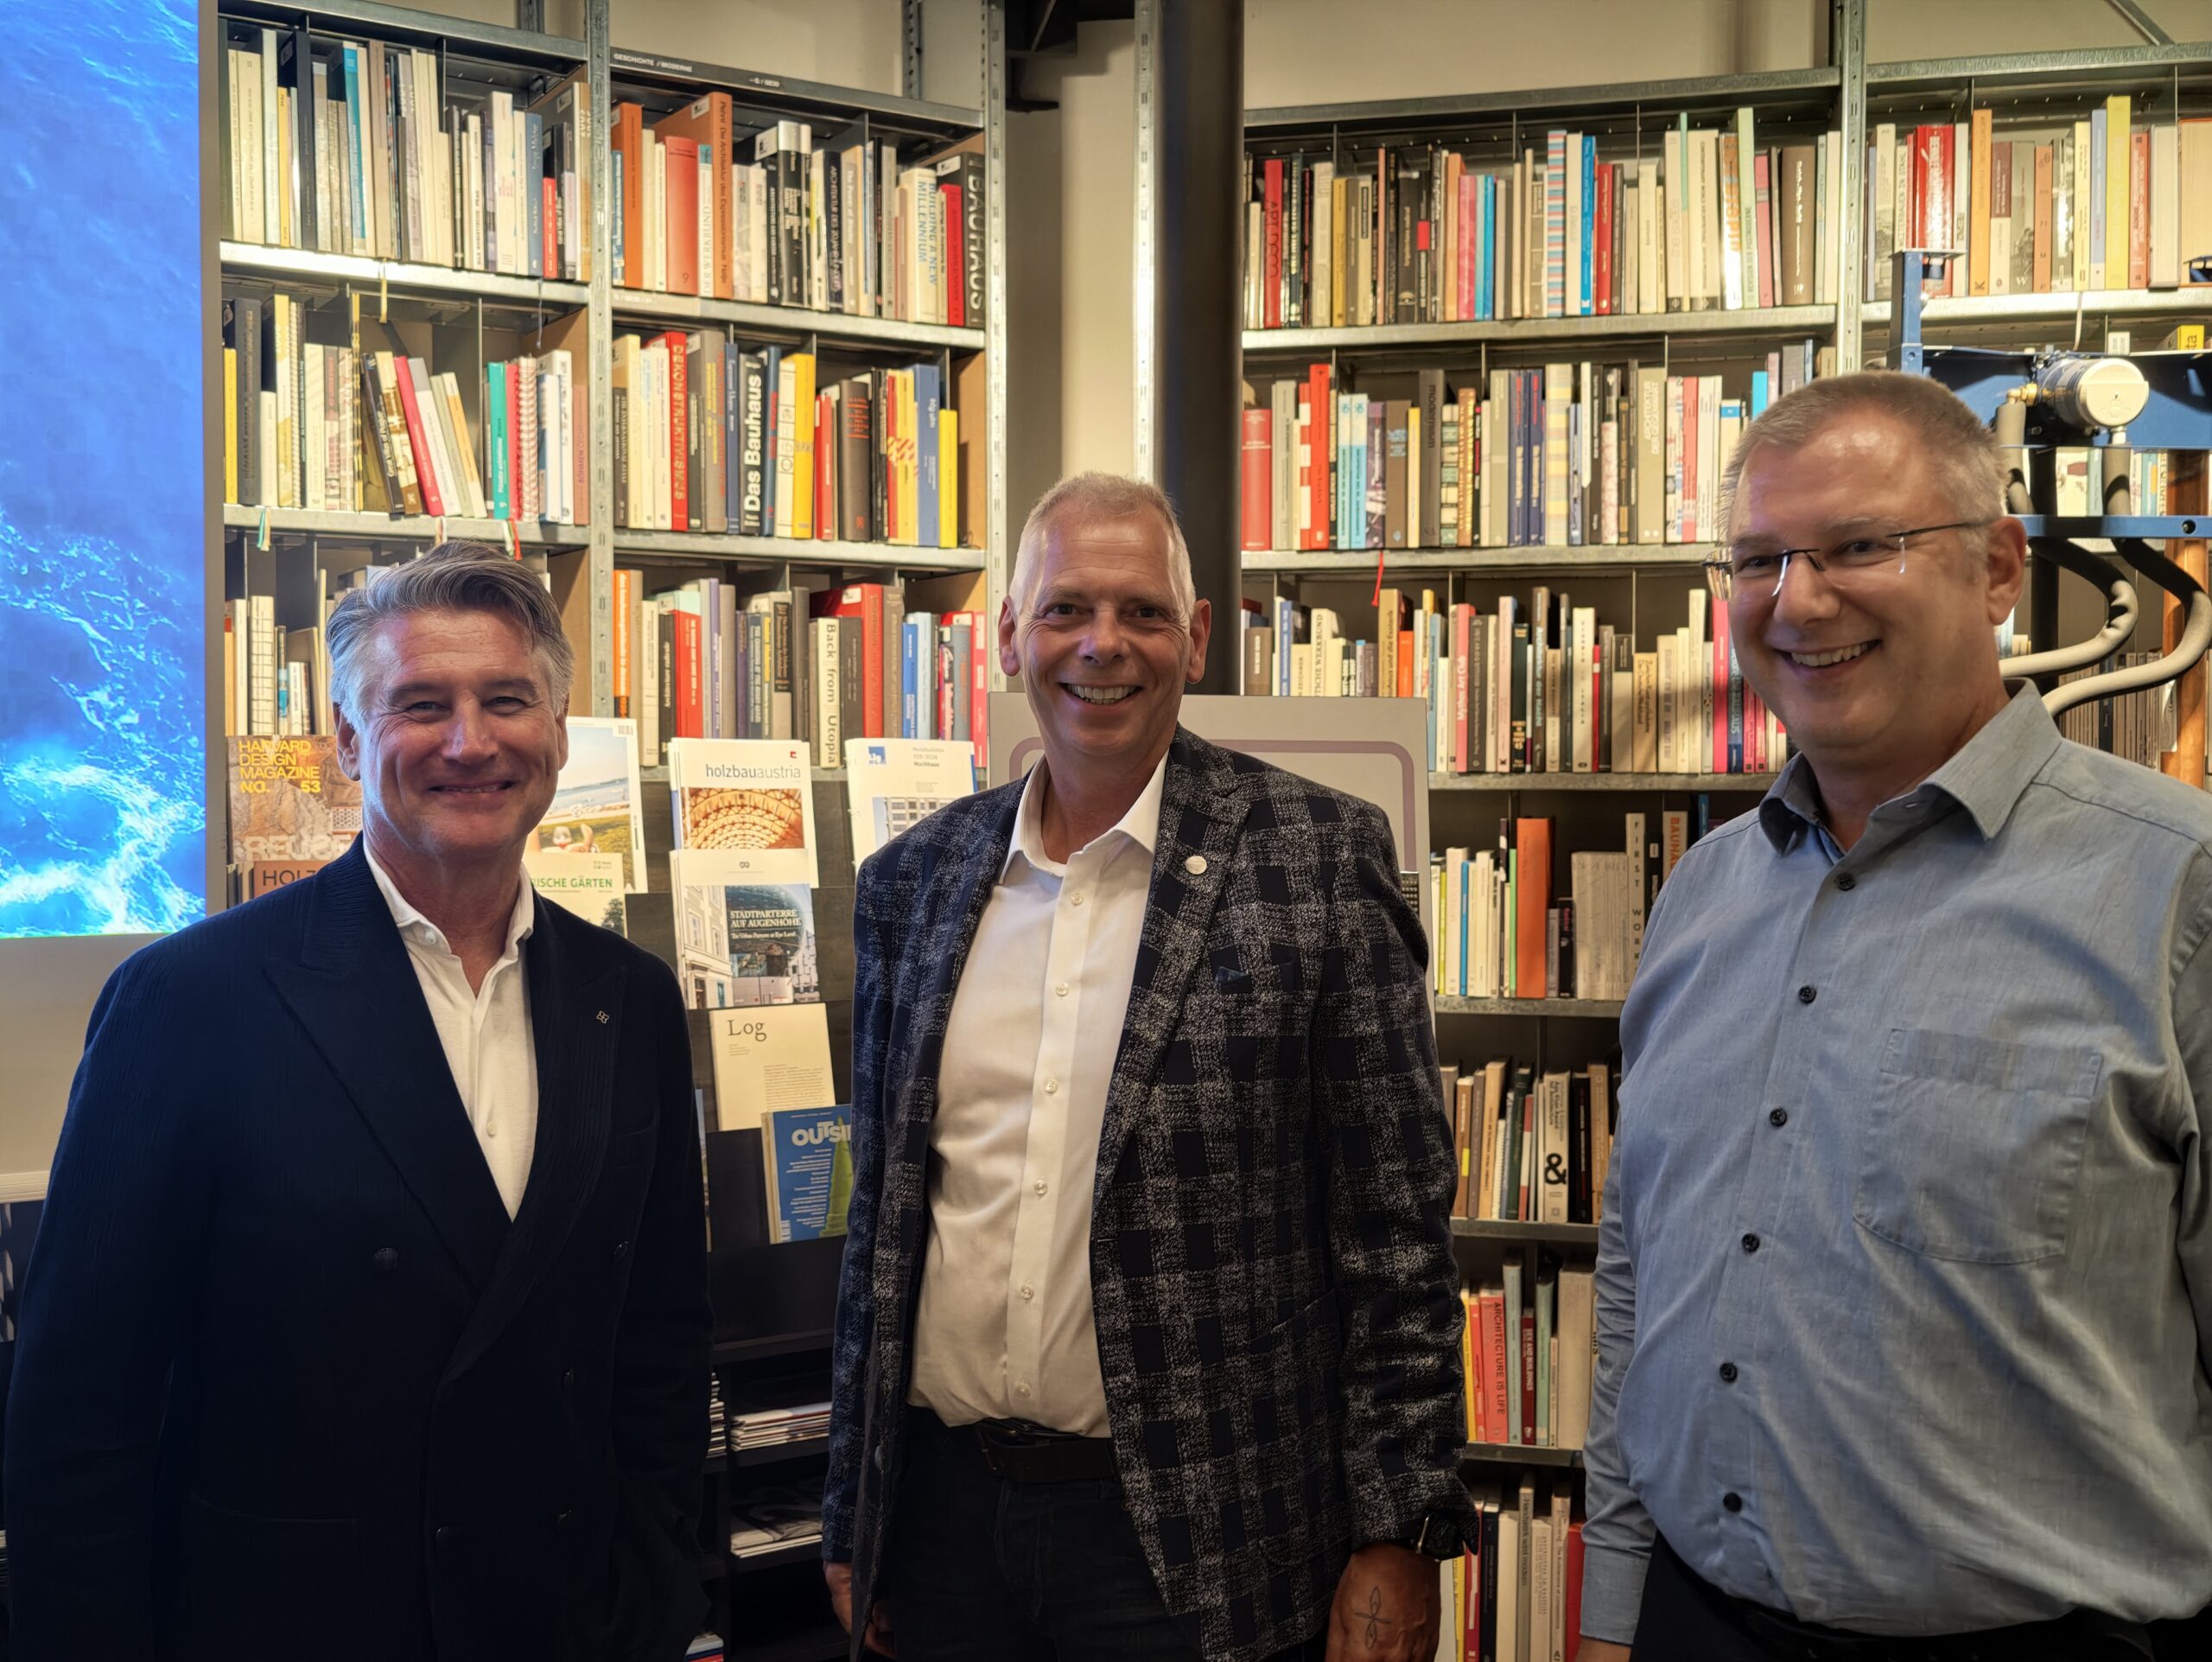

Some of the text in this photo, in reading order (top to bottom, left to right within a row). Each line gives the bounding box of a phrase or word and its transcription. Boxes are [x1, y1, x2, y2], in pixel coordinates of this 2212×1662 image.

[613, 53, 693, 73] GESCHICHTE MODERNE
[719, 141, 728, 181] Architektur
[918, 181, 927, 262] MILLENNIUM
[1265, 201, 1279, 228] ART
[702, 206, 712, 294] DER WERKBUND
[967, 175, 985, 310] BAUHAUS
[672, 344, 685, 500] DEKONSTRUKTIVISMUS
[1427, 385, 1437, 449] modernism
[1643, 381, 1652, 440] ARCHITEKTUR
[744, 374, 761, 512] Das Bauhaus
[1314, 614, 1324, 695] TSCHE WERKBUND
[825, 623, 837, 764] Back from Utopia
[1457, 690, 1466, 720] Mythos
[238, 740, 311, 753] HARVARD
[239, 753, 297, 767] DESIGN
[239, 766, 321, 780] MAGAZINE
[239, 780, 321, 793] NO. 53
[705, 763, 801, 780] holzbauaustria
[570, 877, 613, 888] GÄRTEN
[730, 909, 798, 920] STADTPARTERRE
[730, 917, 802, 928] AUF AUGENHÖHE
[727, 1019, 767, 1042] Log
[1544, 1152, 1567, 1185] &
[1494, 1302, 1505, 1415] ARCHITECTURE IS LIFE
